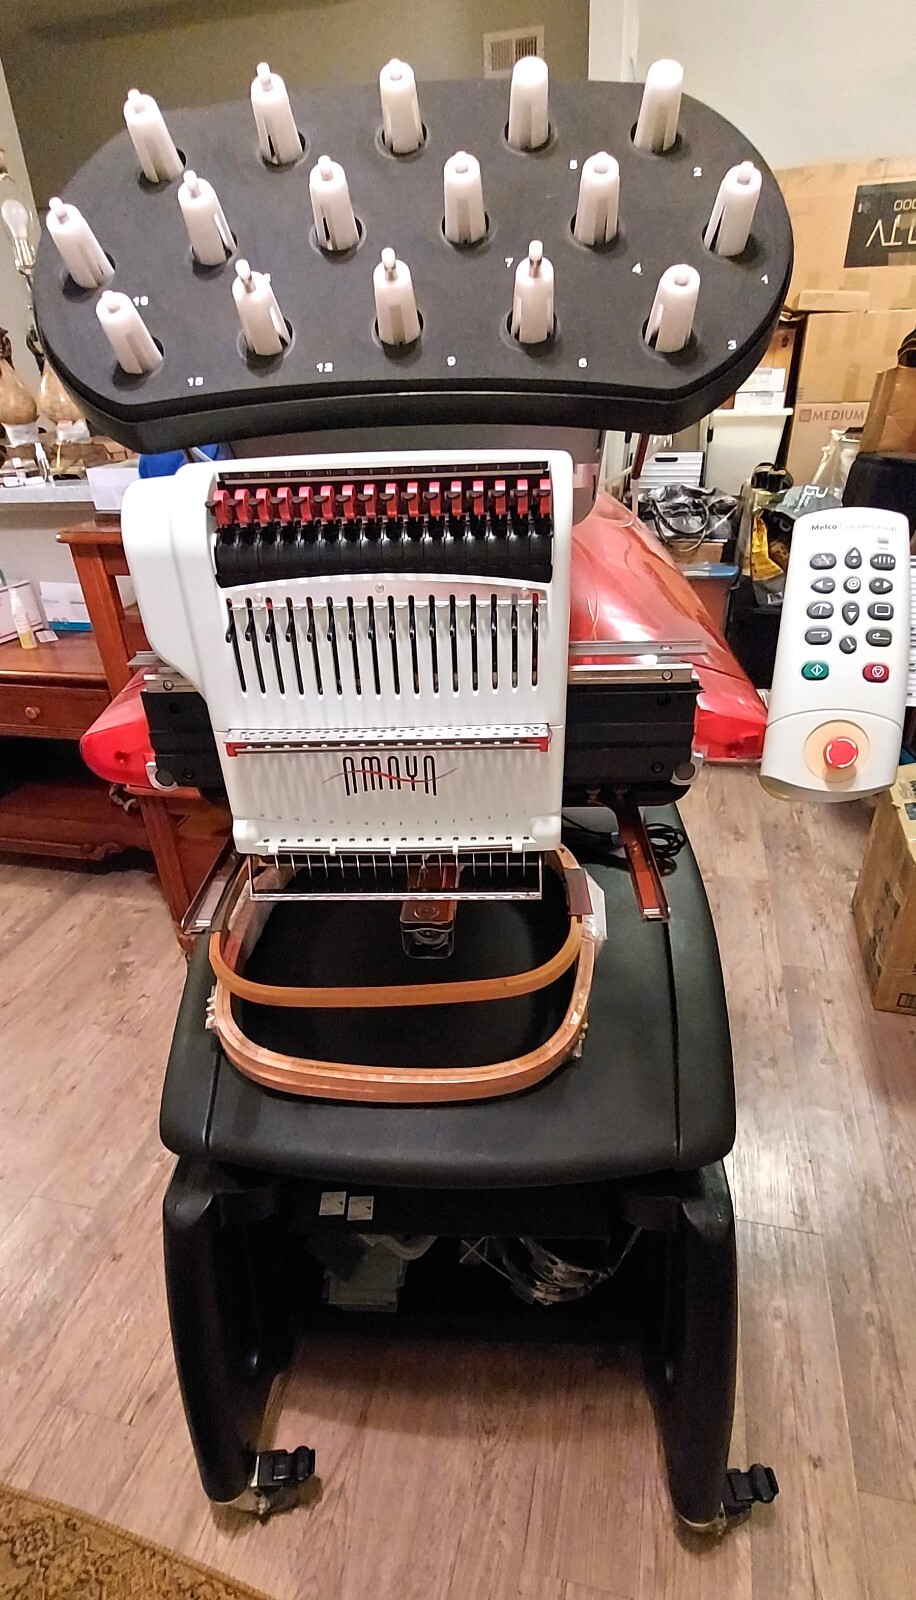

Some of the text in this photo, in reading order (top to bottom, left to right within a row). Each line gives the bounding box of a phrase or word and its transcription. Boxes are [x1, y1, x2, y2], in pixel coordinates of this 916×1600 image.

[693, 167, 702, 177] 2
[504, 257, 514, 268] 7
[632, 262, 641, 275] 4
[760, 274, 769, 285] 1
[727, 339, 737, 351] 3
[446, 356, 456, 367] 9
[578, 357, 588, 368] 6
[316, 362, 333, 373] 12
[813, 409, 864, 421] MEDIUM
[811, 523, 838, 531] Melco
[342, 755, 437, 796] AMAYA
